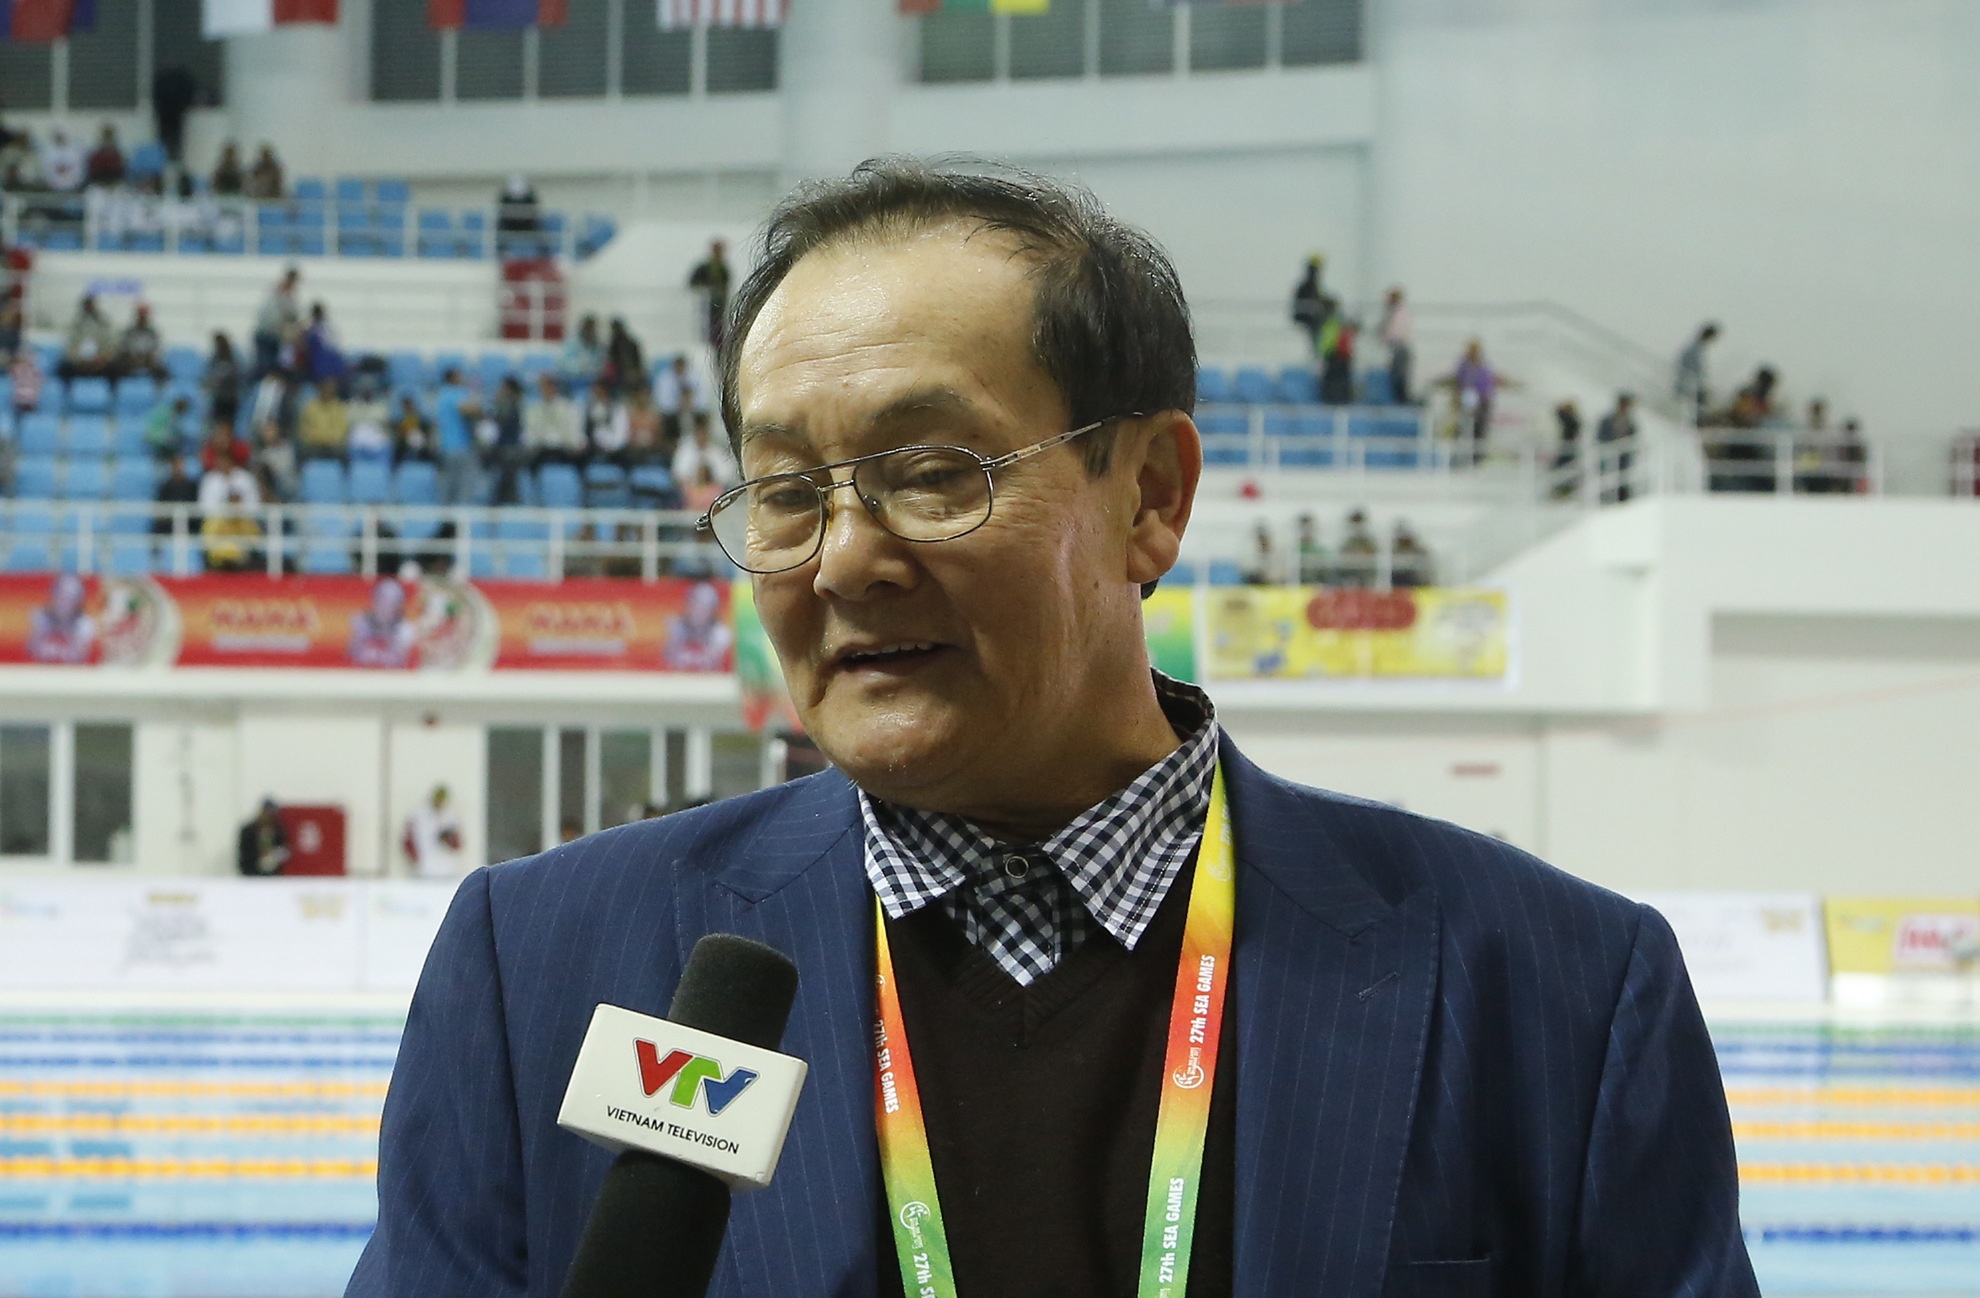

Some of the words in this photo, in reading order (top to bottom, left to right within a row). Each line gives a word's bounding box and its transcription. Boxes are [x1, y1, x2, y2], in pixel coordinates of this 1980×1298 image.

[1196, 954, 1215, 992] GAMES
[1193, 994, 1210, 1015] SEA
[1189, 1017, 1206, 1044] 27th
[877, 1048, 891, 1072] SEA
[634, 1038, 759, 1116] VTV
[881, 1071, 899, 1114] GAMES
[607, 1105, 664, 1132] VIETNAM
[667, 1124, 740, 1154] TELEVISION
[1166, 1178, 1184, 1222] GAMES
[1163, 1224, 1178, 1249] SEA
[913, 1252, 932, 1285] 27th
[1159, 1252, 1175, 1283] 27th
